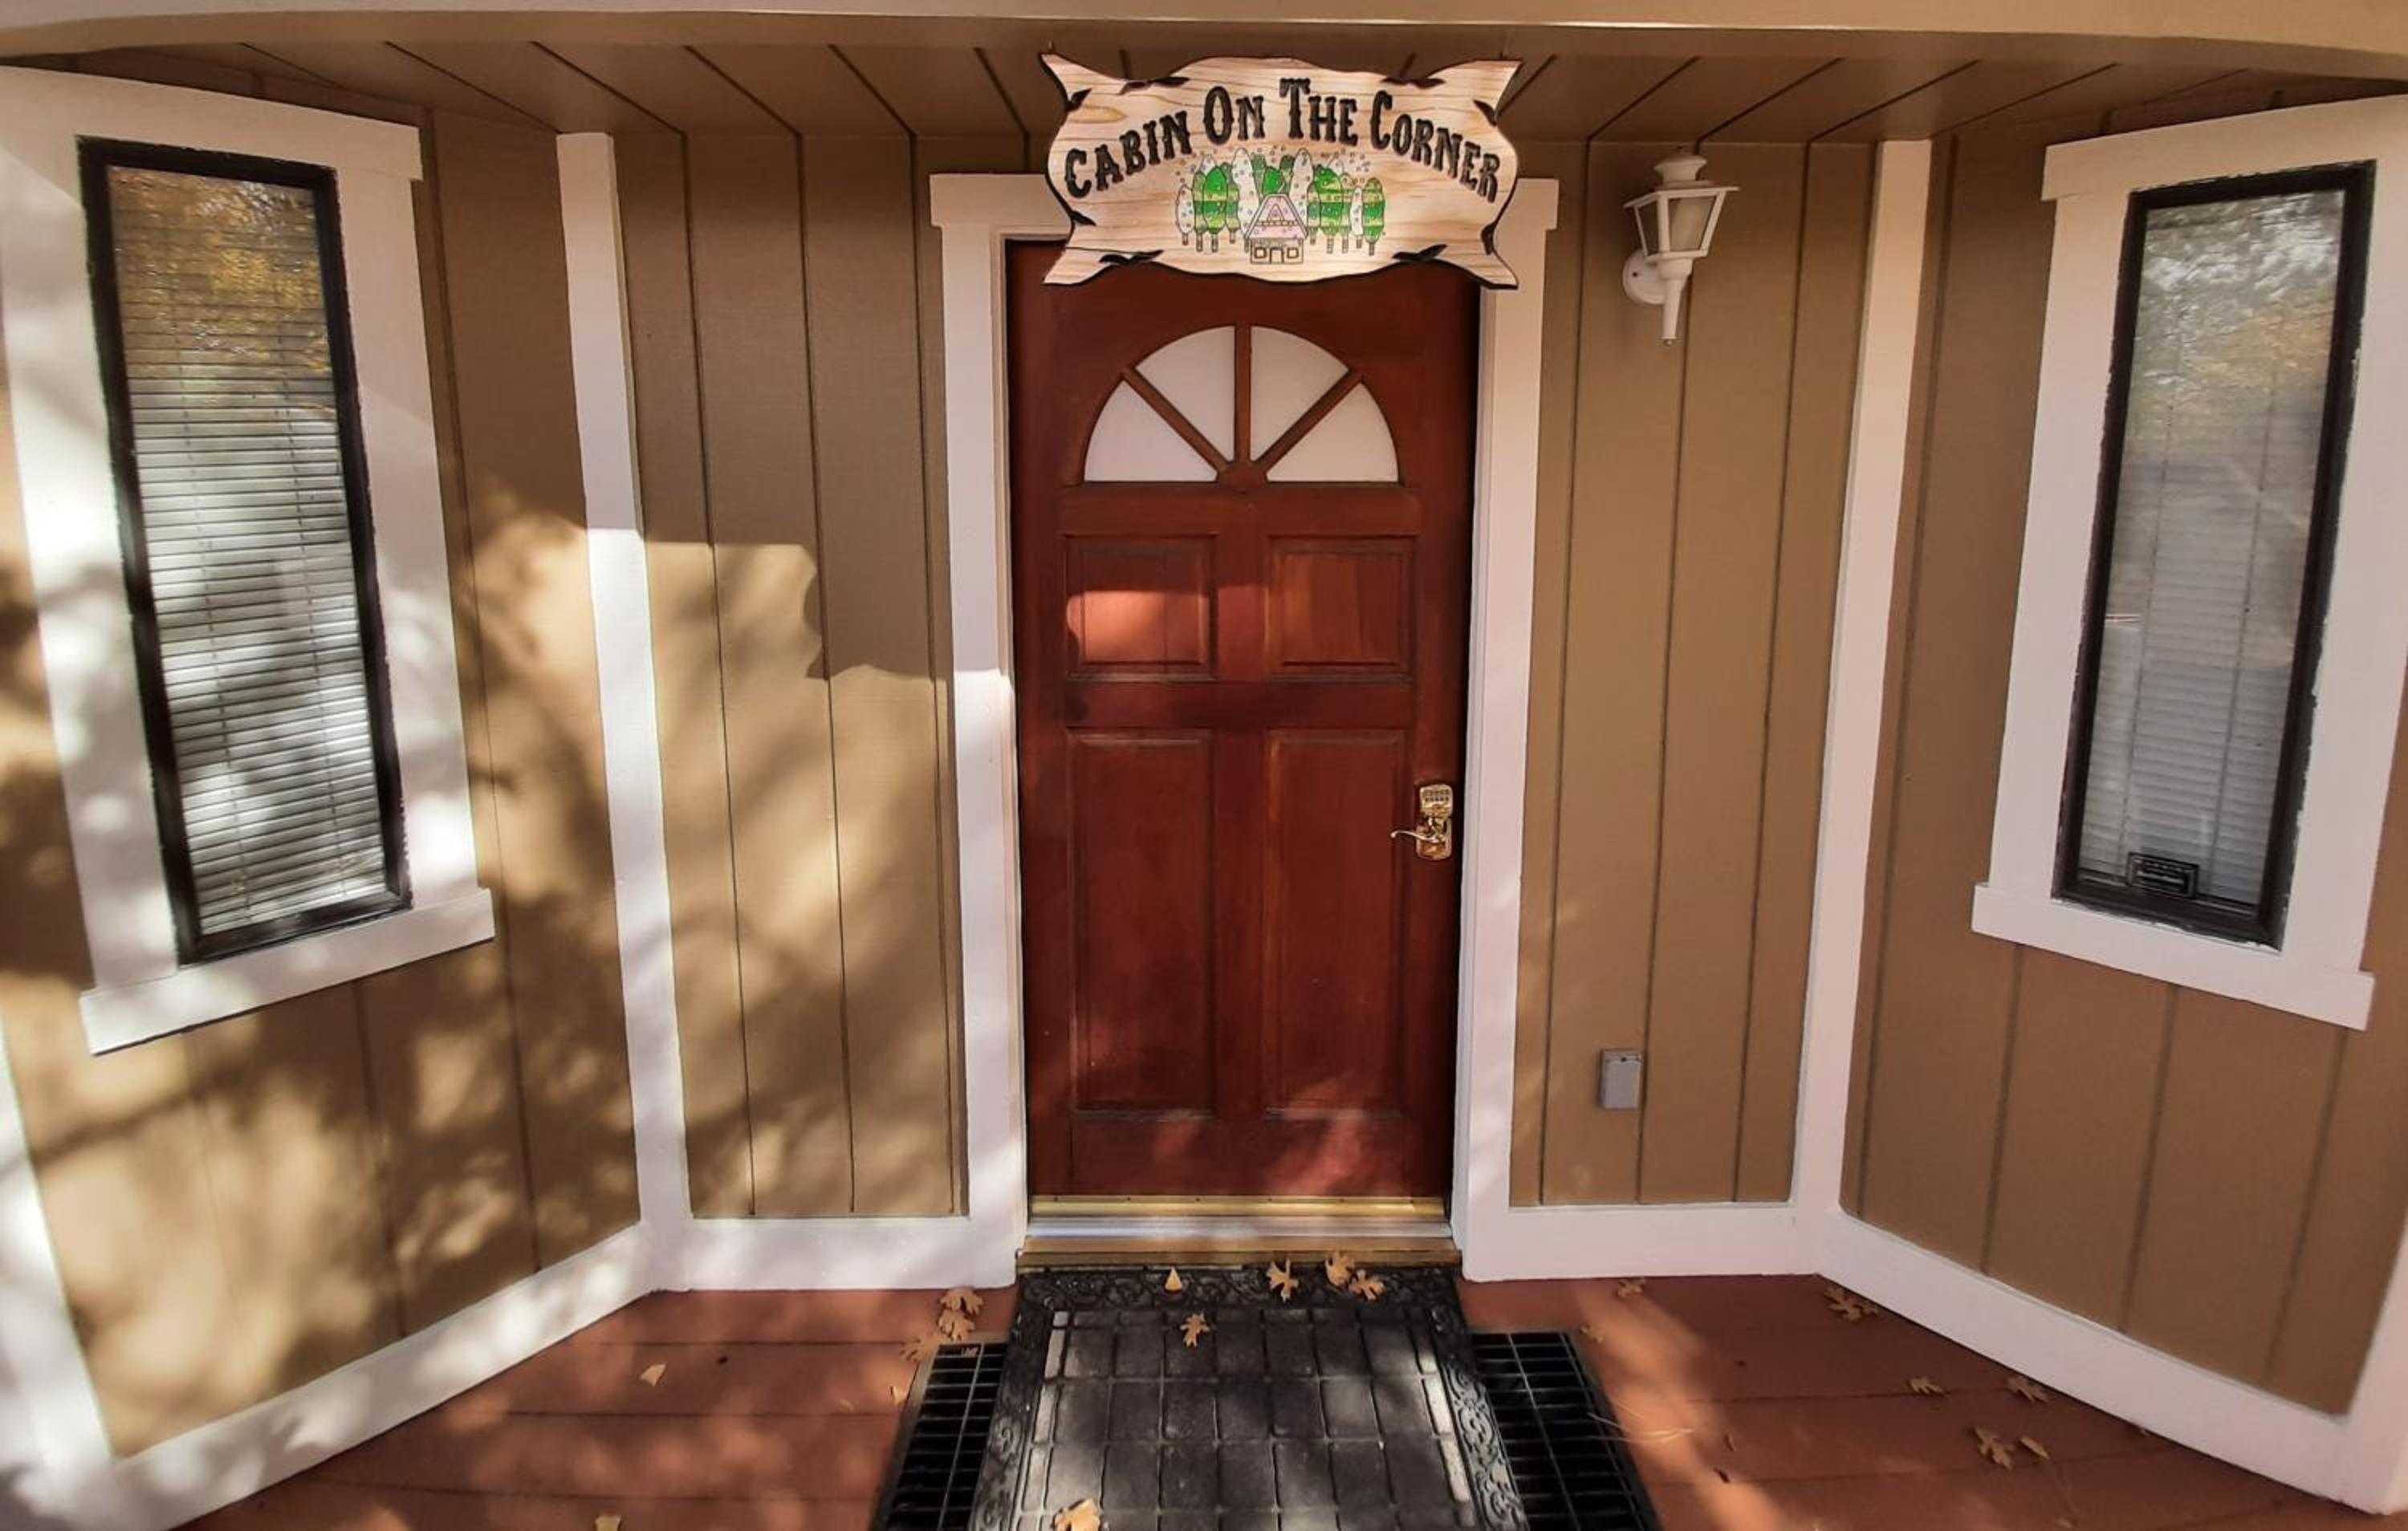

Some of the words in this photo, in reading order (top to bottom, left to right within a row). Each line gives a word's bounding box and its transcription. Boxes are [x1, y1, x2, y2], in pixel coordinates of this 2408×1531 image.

[1064, 111, 1193, 198] CABIN
[1204, 86, 1264, 144] ON
[1279, 79, 1358, 146] THE
[1370, 91, 1501, 202] CORNER
